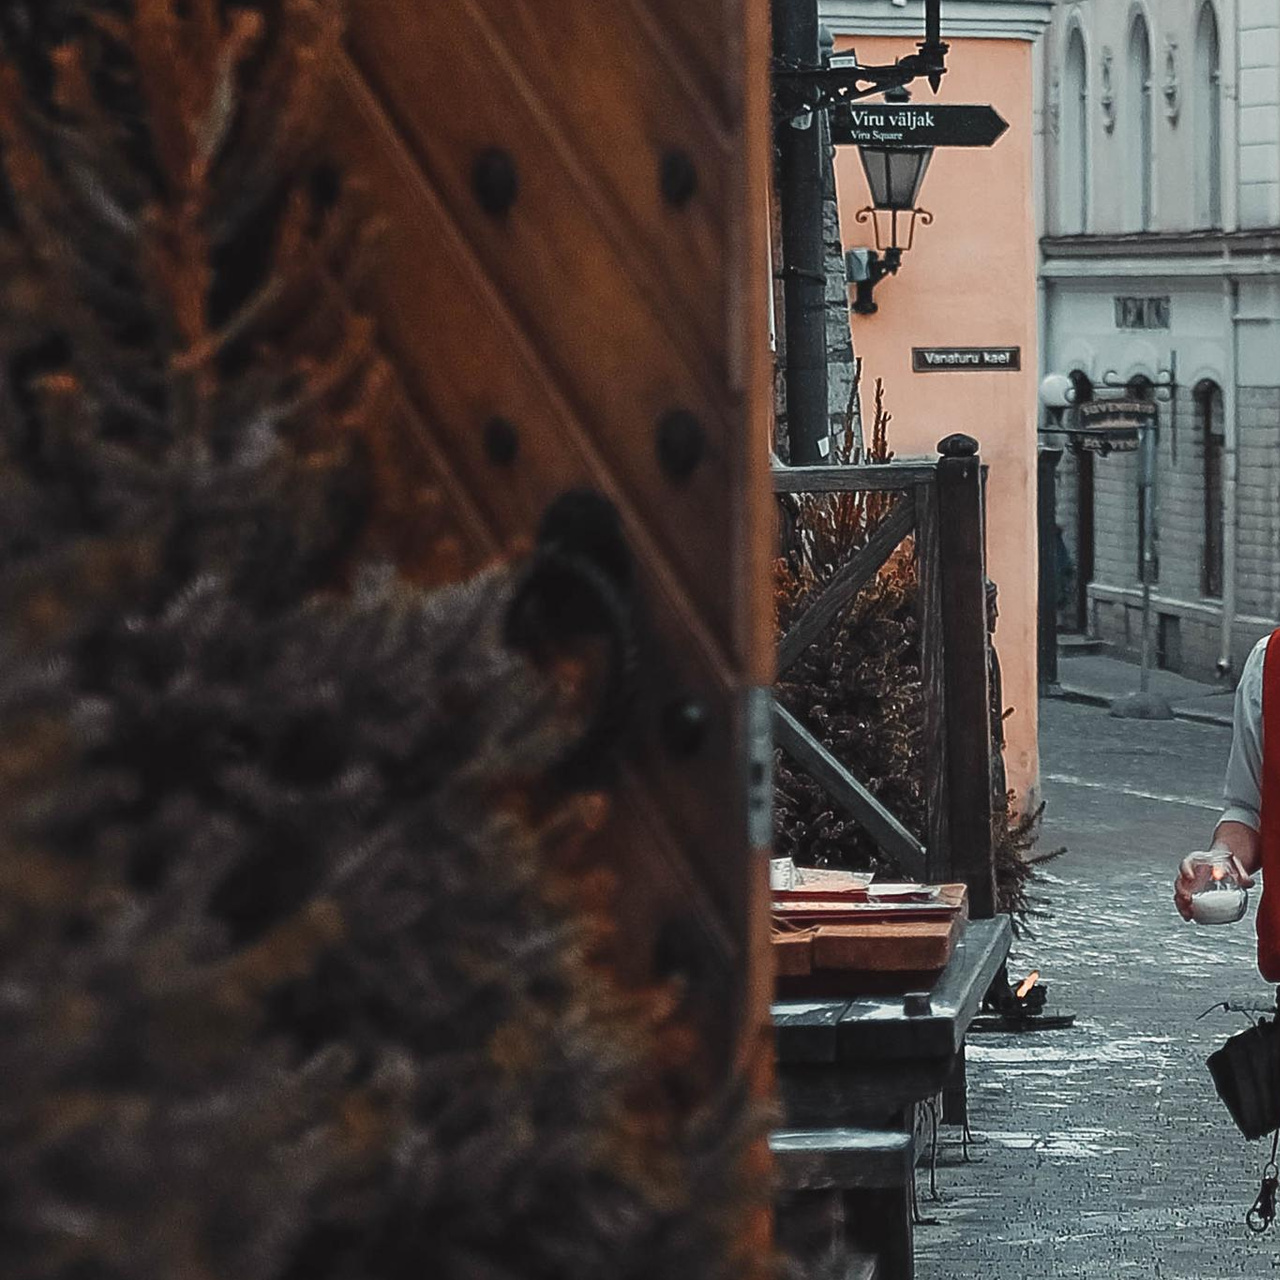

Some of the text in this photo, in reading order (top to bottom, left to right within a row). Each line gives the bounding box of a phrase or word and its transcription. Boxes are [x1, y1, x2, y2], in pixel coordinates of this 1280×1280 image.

[851, 111, 935, 131] Viru väljak
[851, 130, 903, 142] Viru Square
[924, 351, 1011, 364] Vanaturu kael
